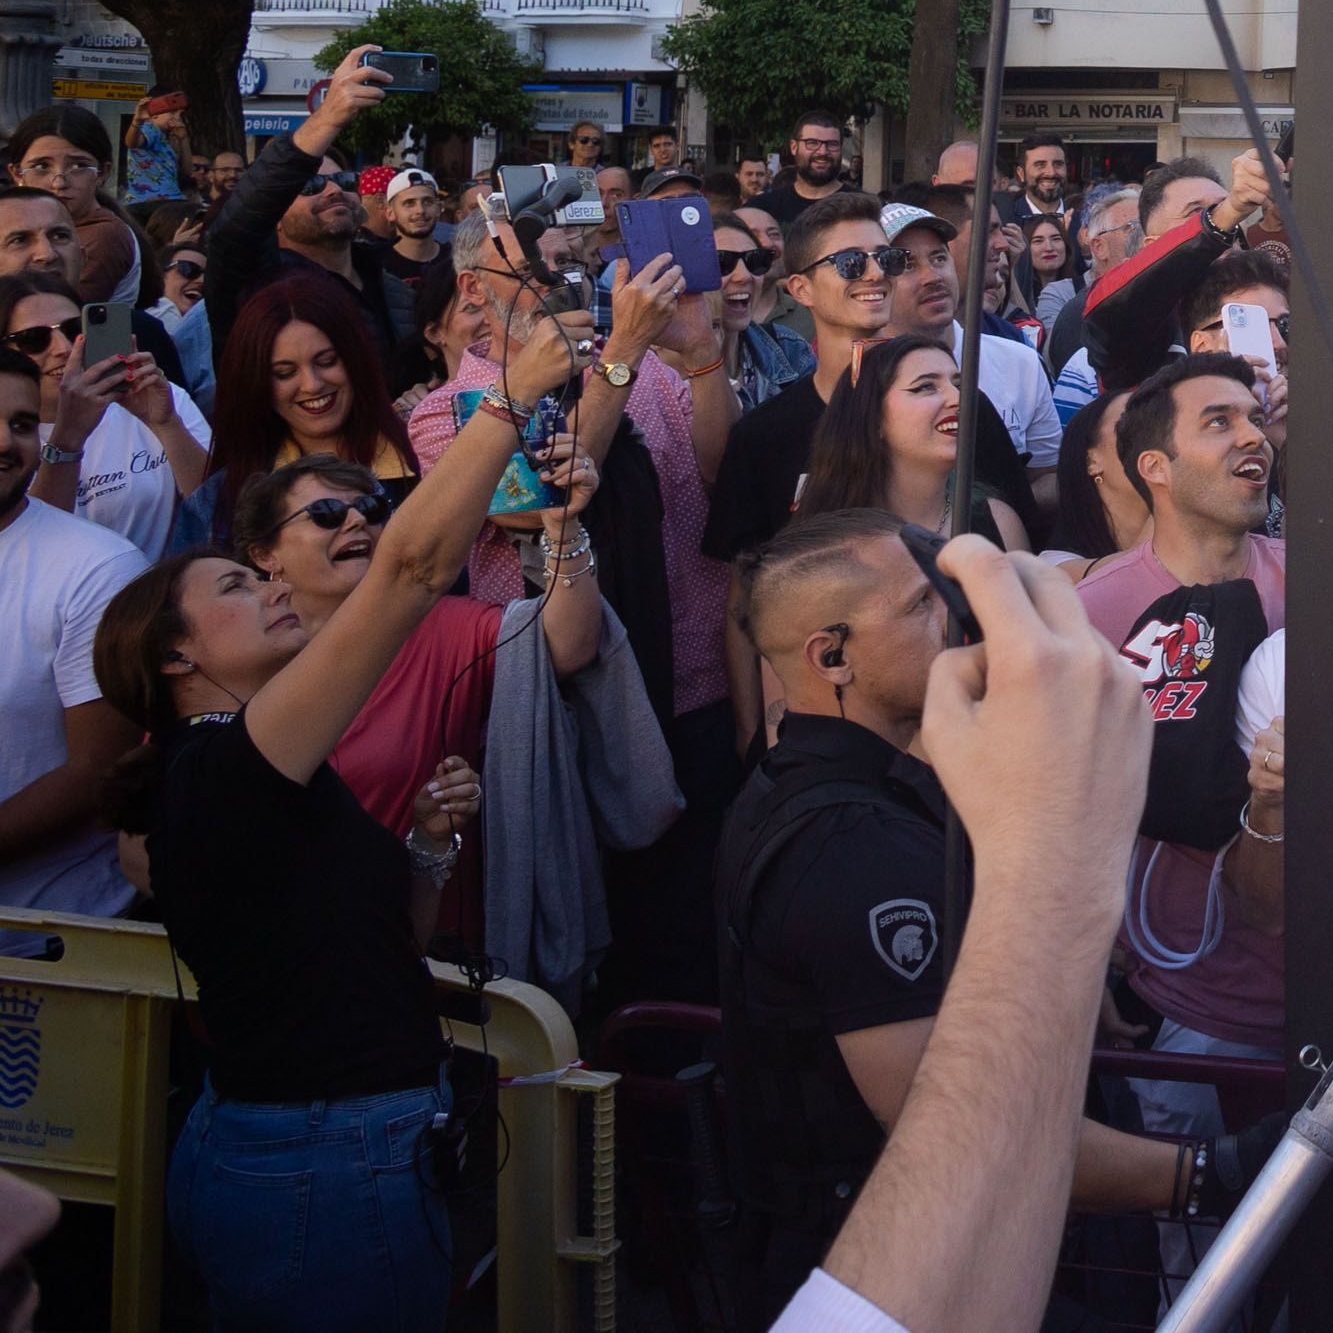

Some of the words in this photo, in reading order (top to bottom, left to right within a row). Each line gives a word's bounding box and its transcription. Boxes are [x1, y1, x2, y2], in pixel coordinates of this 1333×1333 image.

[1014, 104, 1049, 117] BAR
[1058, 104, 1080, 118] LA
[1088, 104, 1164, 119] NOTARIA
[568, 205, 594, 218] Jerez
